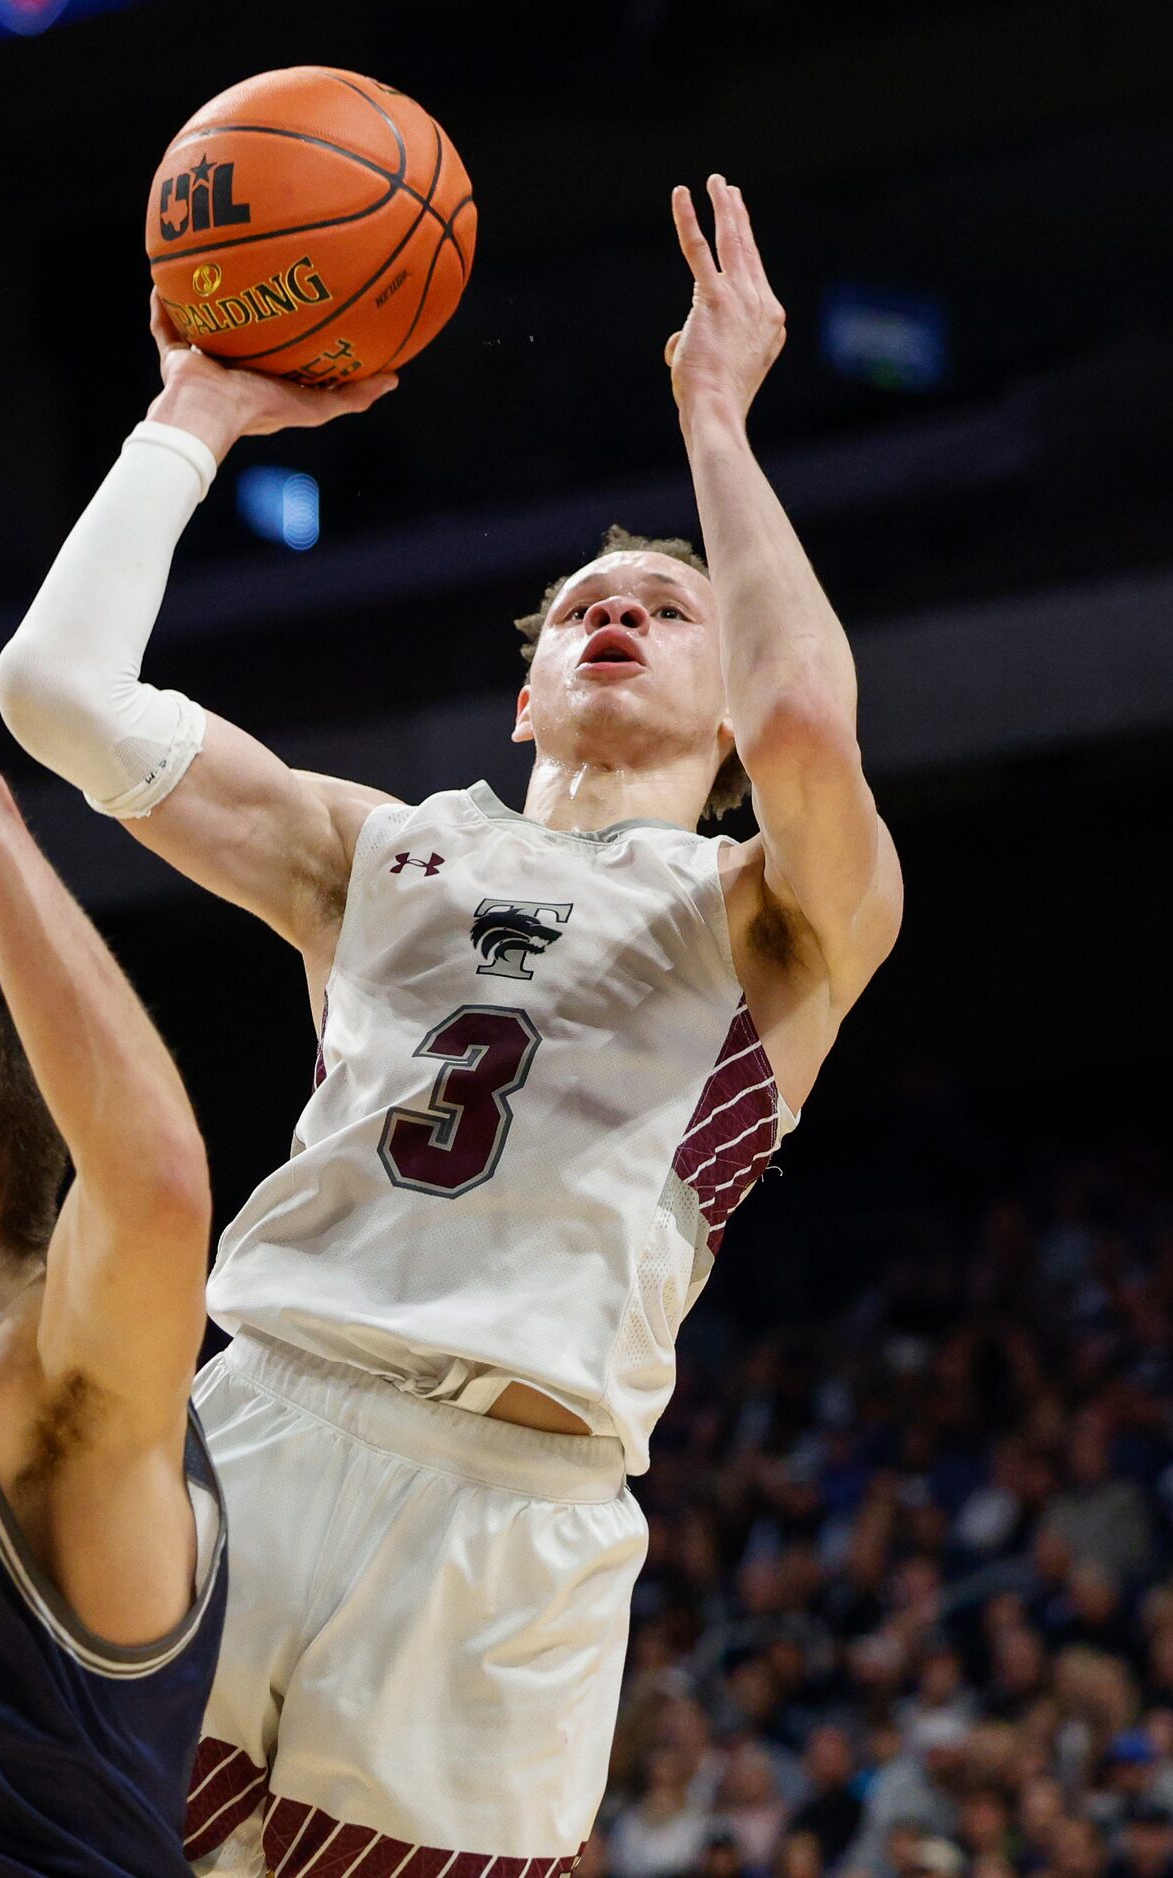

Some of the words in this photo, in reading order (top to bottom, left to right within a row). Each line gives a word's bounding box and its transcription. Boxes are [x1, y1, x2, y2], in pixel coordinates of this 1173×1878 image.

[160, 153, 251, 241] UIL
[166, 256, 333, 338] PALDING
[376, 1004, 543, 1200] 3
